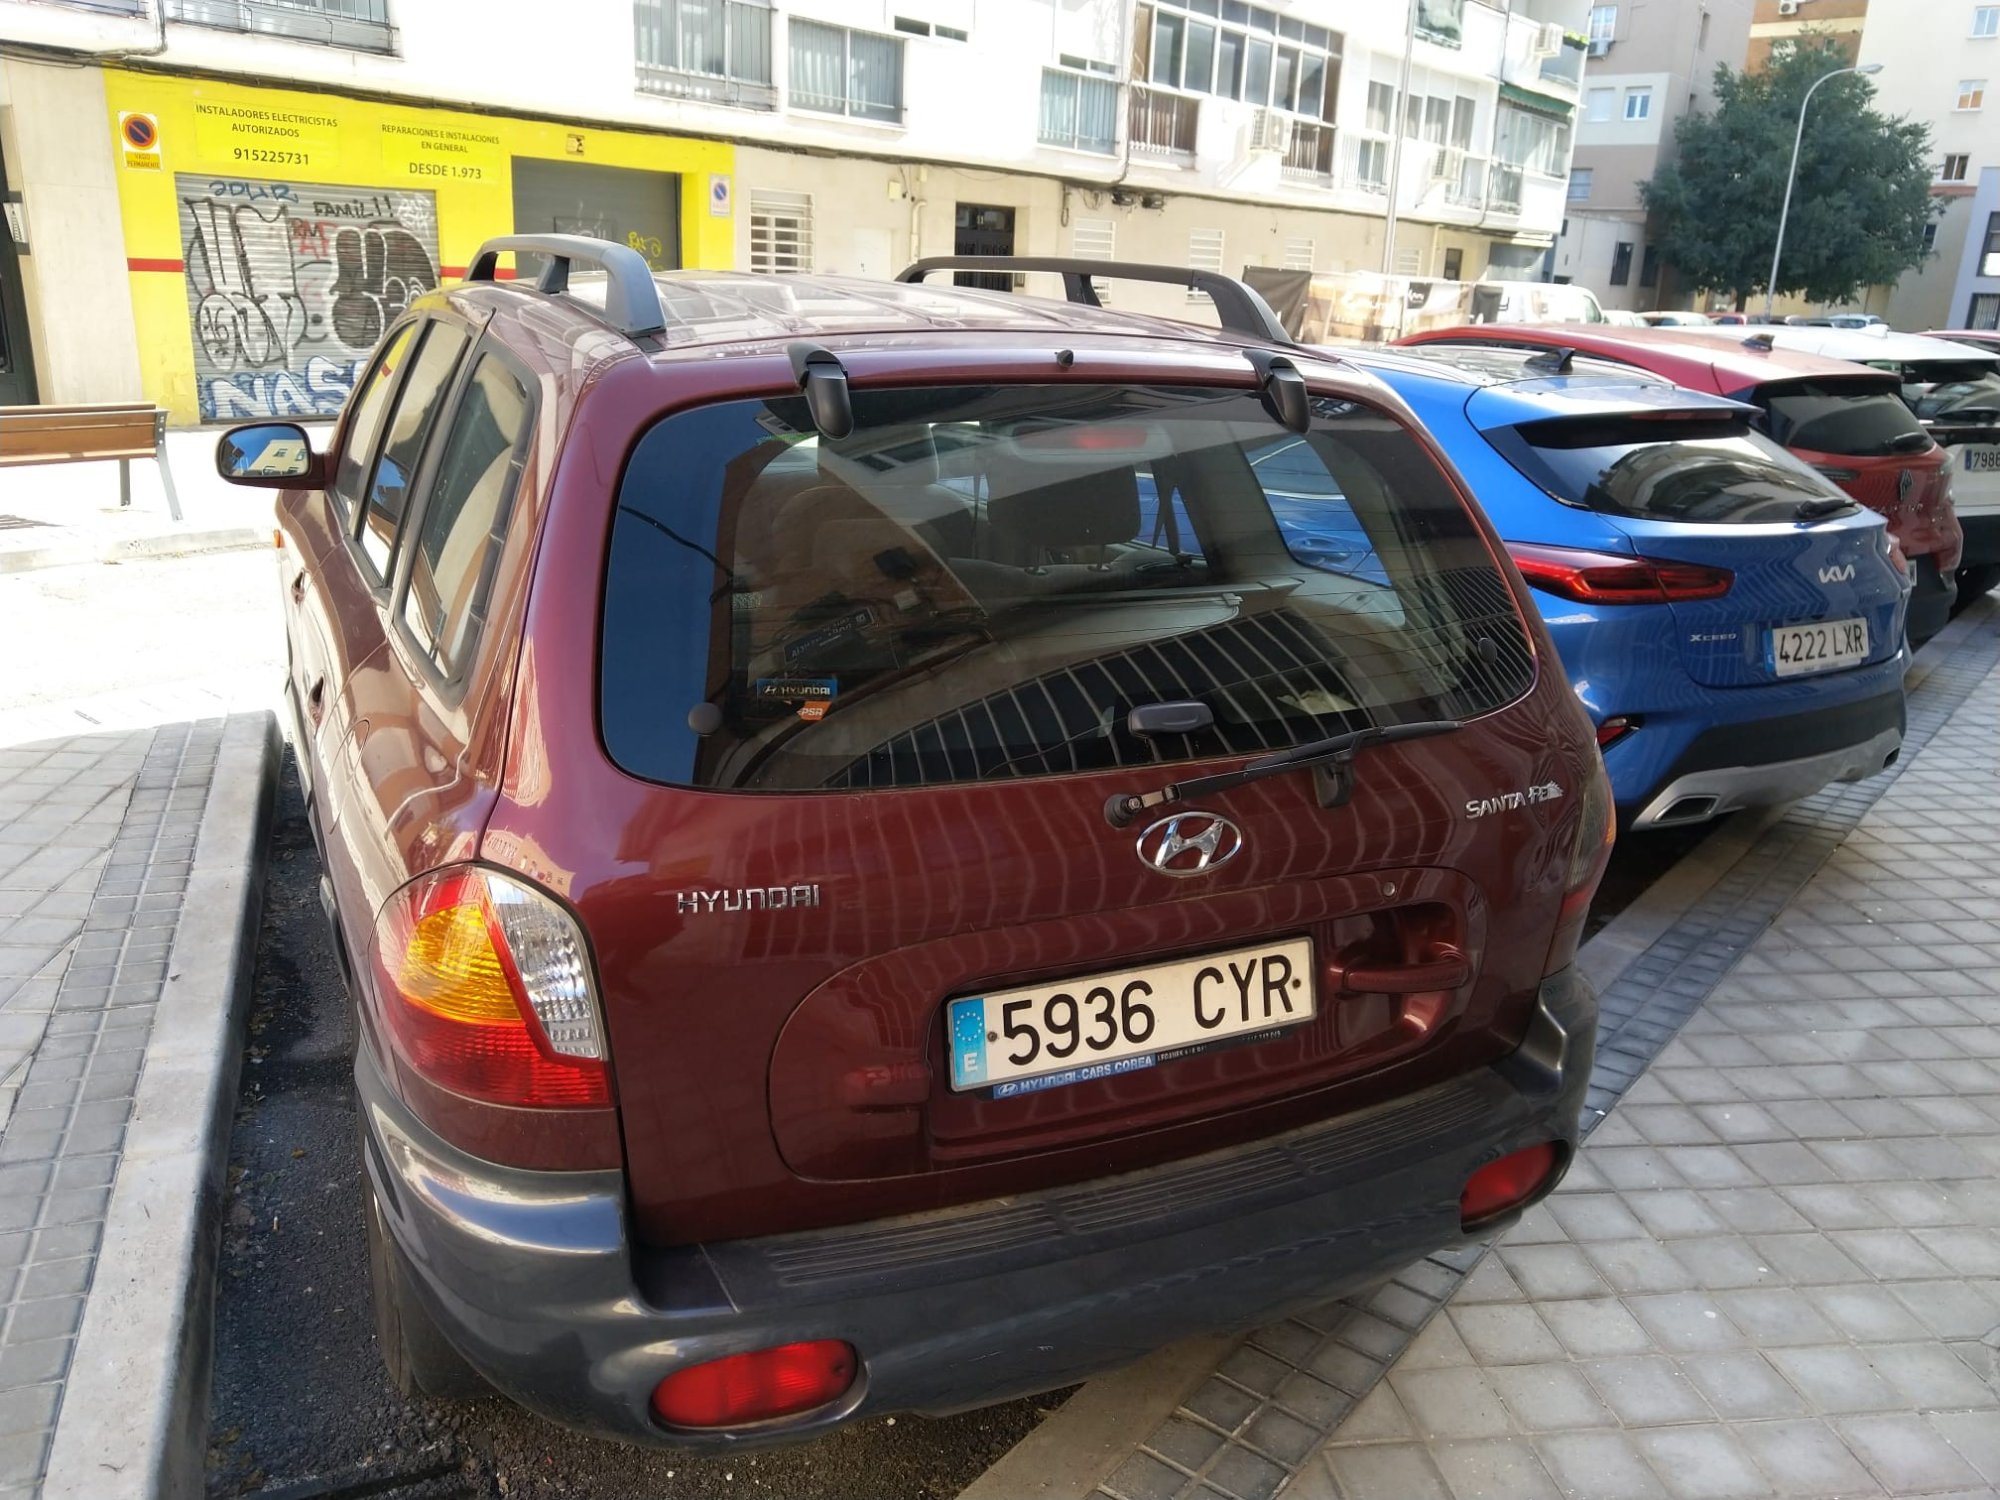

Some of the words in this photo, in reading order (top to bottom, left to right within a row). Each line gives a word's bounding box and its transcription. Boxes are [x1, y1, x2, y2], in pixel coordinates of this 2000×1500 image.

[196, 104, 270, 120] INSTALADORES
[272, 112, 338, 127] ELECTRICISTAS
[231, 123, 300, 138] AUTORIZADOS
[382, 124, 439, 138] REPARACIONES
[440, 130, 445, 139] E
[446, 131, 500, 145] INSTALACIONES
[233, 147, 309, 165] 915225731
[421, 141, 432, 150] EN
[433, 142, 468, 153] GENERAL
[409, 162, 448, 176] DESDE
[452, 166, 482, 179] 1.973
[1778, 629, 1827, 664] 4222
[1832, 623, 1865, 656] LXR
[781, 686, 831, 695] HYUNDAI
[1465, 791, 1527, 819] SANTA
[677, 884, 820, 914] HYUNDAI
[1002, 979, 1156, 1066] 5936
[1193, 954, 1295, 1030] CYR
[963, 1051, 978, 1072] E
[1114, 1055, 1153, 1072] COREA
